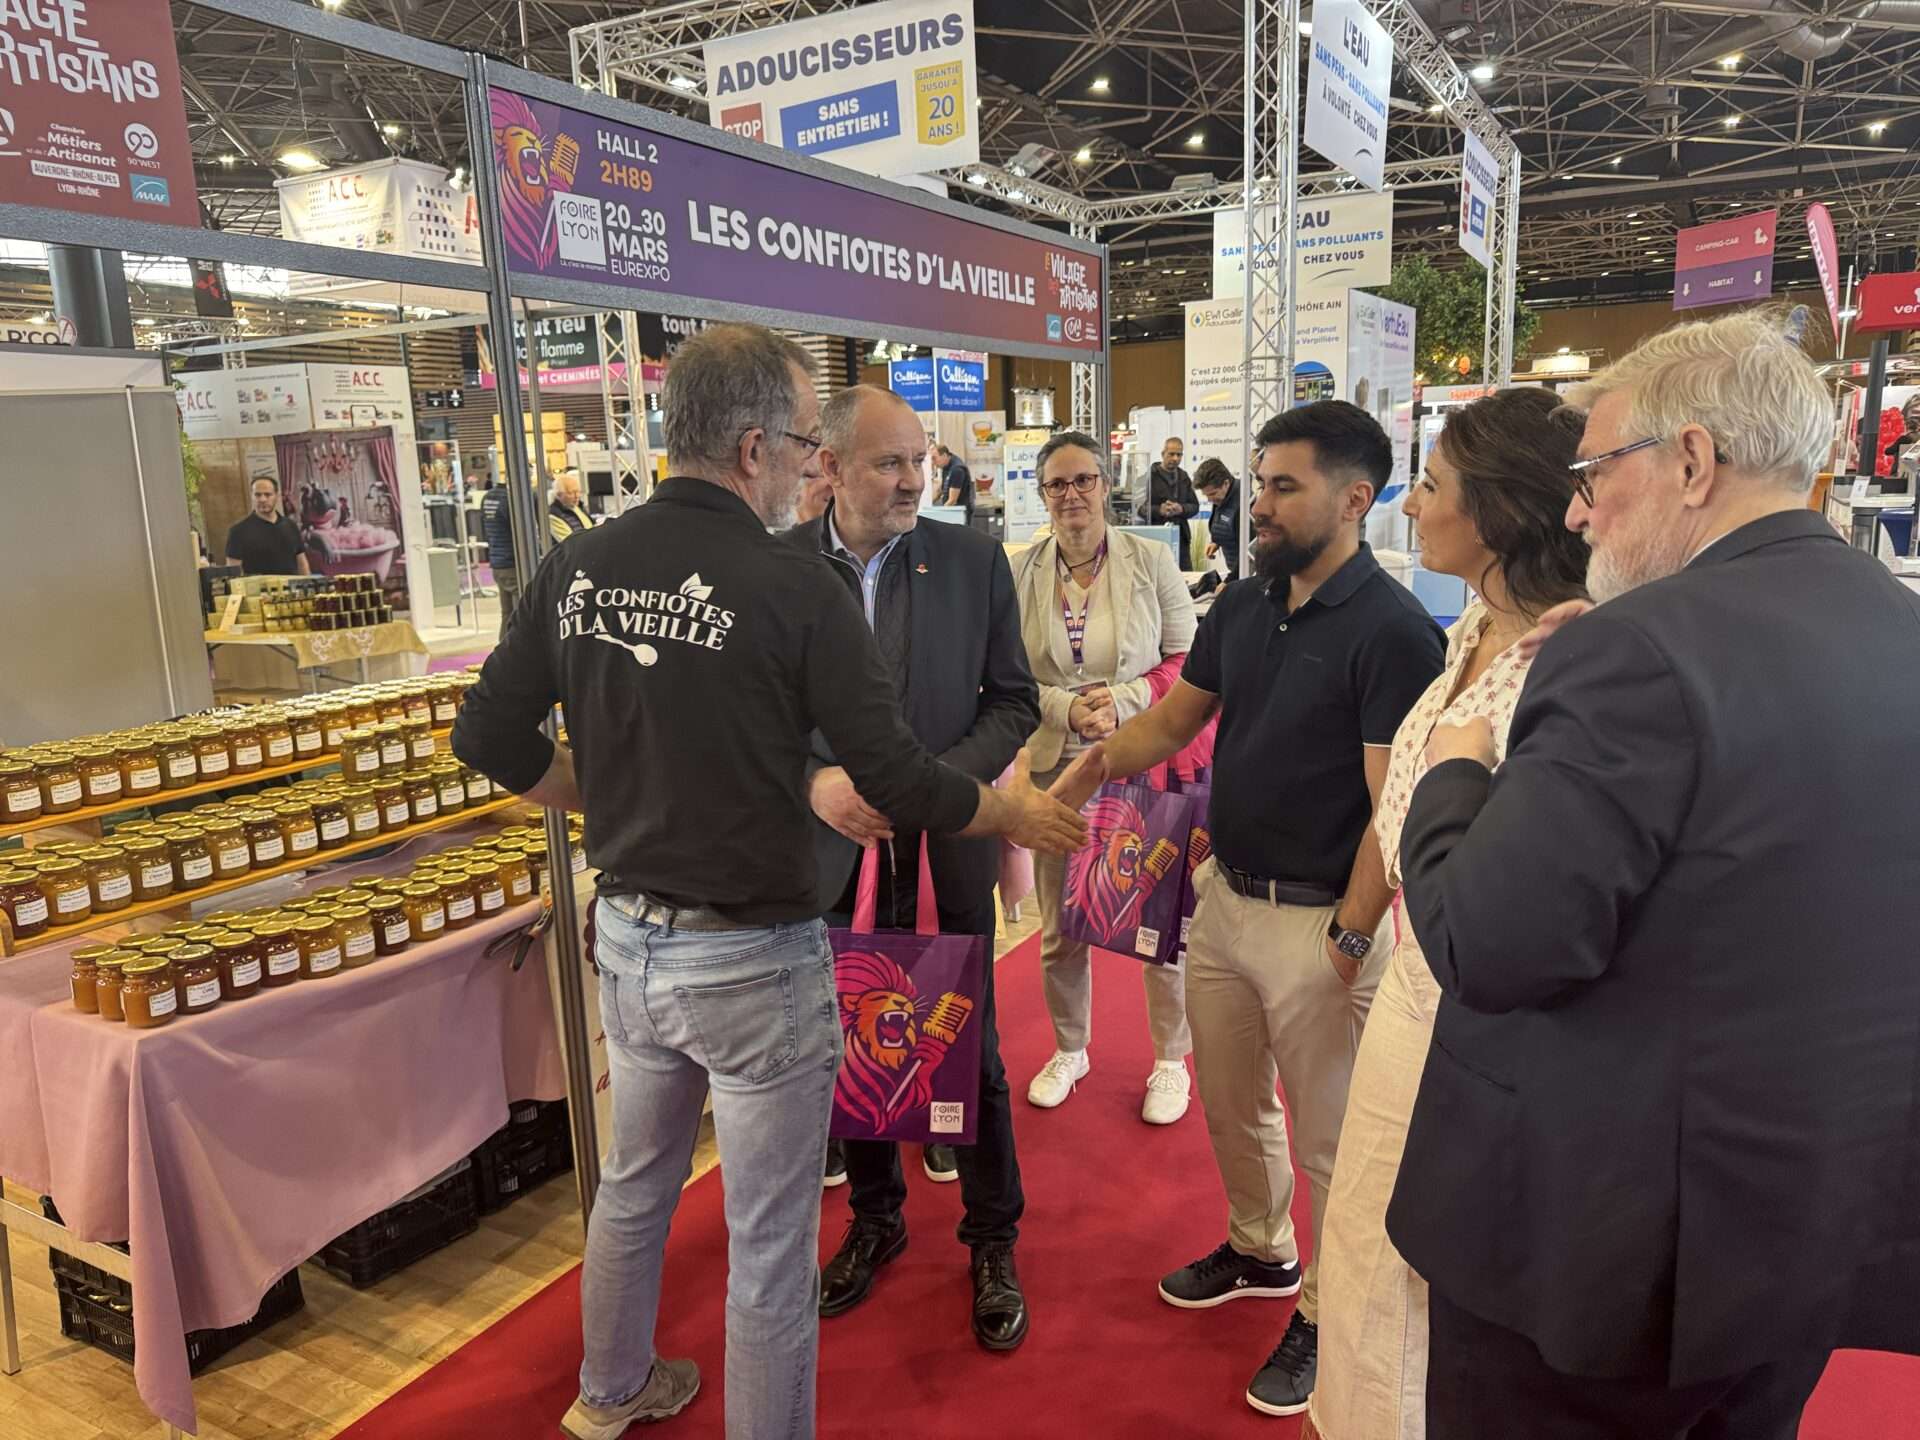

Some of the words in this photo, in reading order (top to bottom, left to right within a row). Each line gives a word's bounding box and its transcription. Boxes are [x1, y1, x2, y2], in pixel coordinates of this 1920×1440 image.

[1344, 16, 1370, 68] L'EAU
[716, 13, 964, 96] ADOUCISSEURS
[1316, 41, 1331, 69] SANS
[915, 65, 960, 82] GARANTIE
[818, 98, 860, 121] SANS
[928, 95, 955, 120] 20
[1328, 86, 1351, 120] VOLONTÉ
[1353, 109, 1366, 133] CHEZ
[1366, 122, 1378, 142] VOUS
[50, 123, 86, 135] Chambre
[797, 114, 882, 147] ENTRETIEN
[927, 125, 953, 140] ANS
[47, 132, 102, 152] Métiers
[597, 130, 645, 161] HALL
[648, 143, 658, 164] 2
[600, 160, 652, 192] 2H89
[560, 200, 597, 221] FOIRE
[562, 220, 599, 242] LYON
[1319, 231, 1384, 246] POLLUANTS
[608, 230, 669, 264] MARS
[688, 200, 750, 251] LES
[758, 216, 911, 282] CONFIOTES
[967, 263, 1036, 306] VIEILLE
[1695, 236, 1740, 252] CAMPING-CAR
[1304, 253, 1333, 265] CHEZ
[1335, 250, 1365, 262] VOUS
[611, 258, 671, 282] EUREXPO
[1051, 252, 1087, 288] VILLAGE
[1708, 277, 1735, 289] HABITAT
[1059, 285, 1098, 313] ARTISANS
[1327, 300, 1341, 309] AIN
[554, 316, 586, 333] feu
[661, 315, 697, 333] tout
[541, 339, 585, 358] flamme
[550, 368, 600, 384] CHEMINÉES
[894, 371, 932, 386] Culligan
[941, 365, 980, 390] Culligan
[1190, 376, 1218, 386] équipés
[1191, 368, 1210, 376] C'est
[1223, 365, 1236, 373] 000
[557, 592, 585, 618] LES
[595, 588, 736, 629] CONFIOTES
[559, 611, 608, 640] D'LA
[617, 610, 728, 651] VIEILLE
[1138, 937, 1156, 948] LYON
[934, 1115, 960, 1123] LYON
